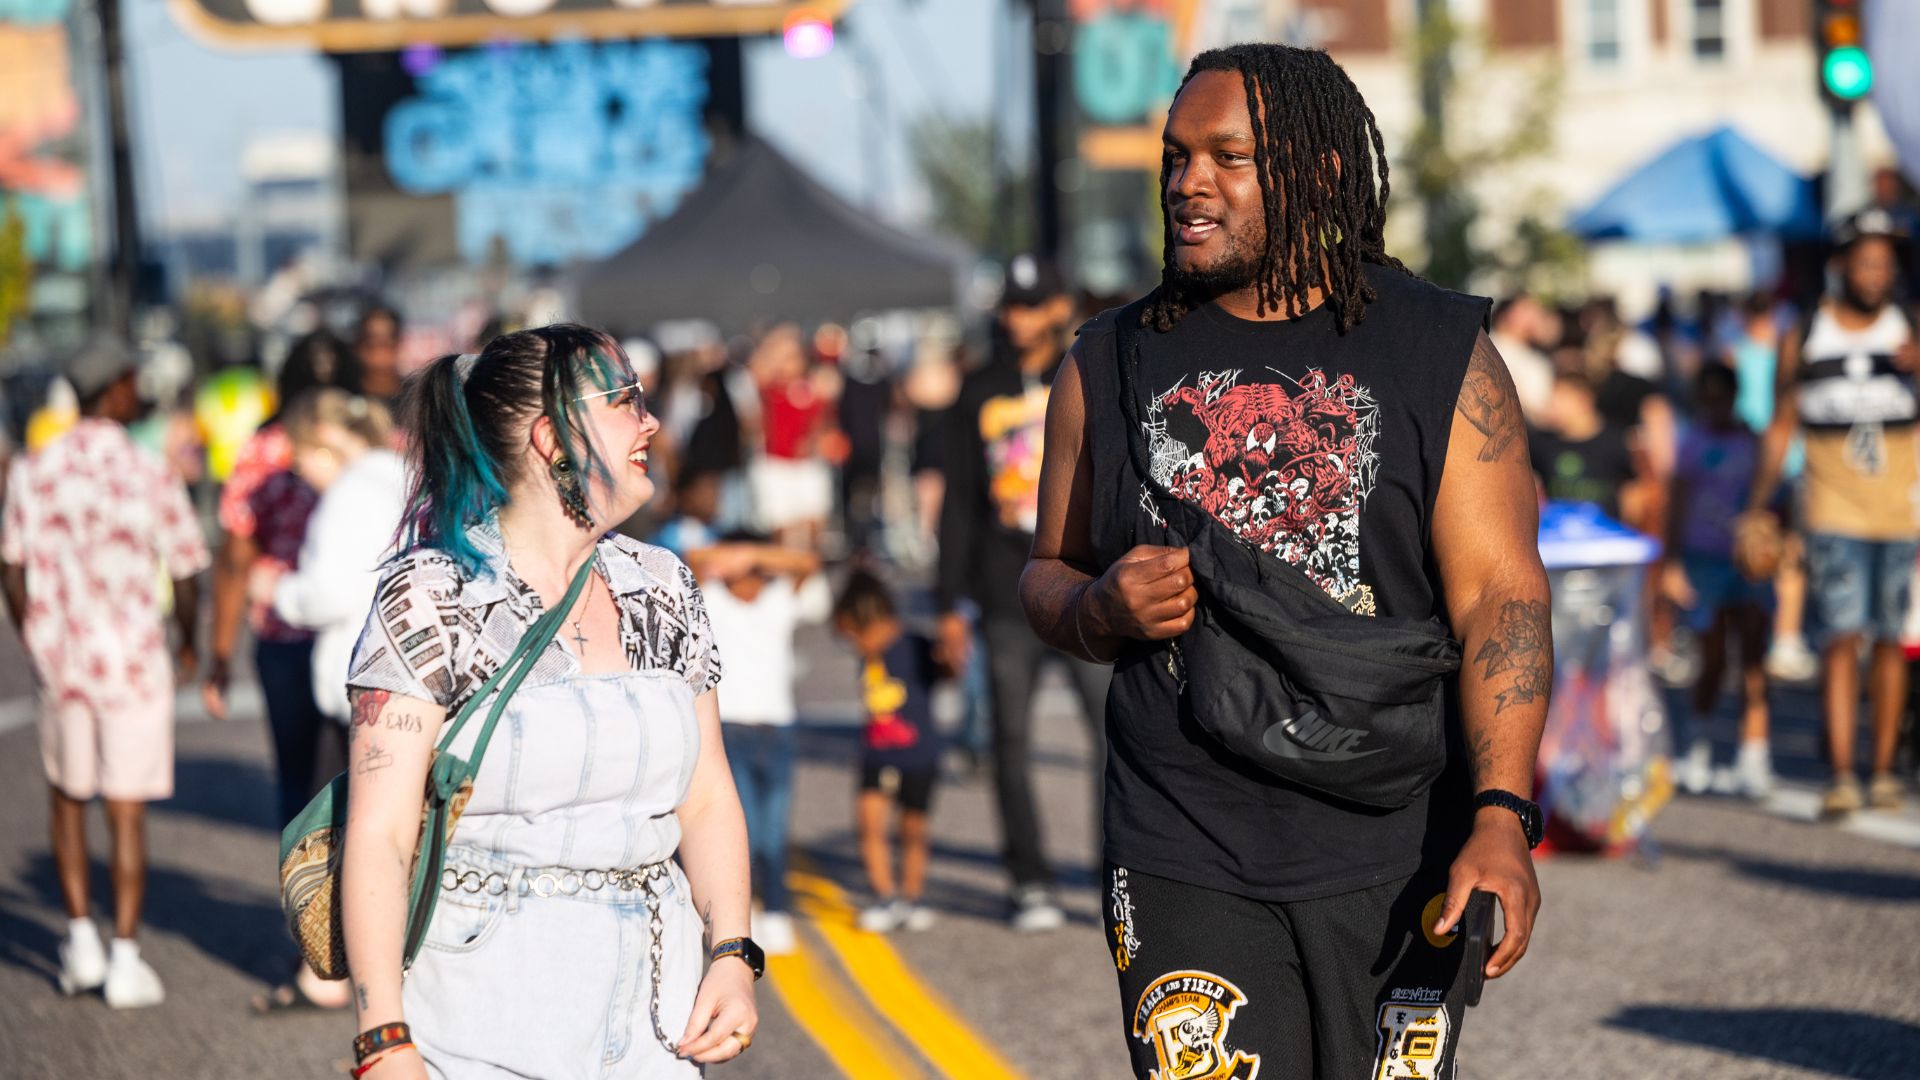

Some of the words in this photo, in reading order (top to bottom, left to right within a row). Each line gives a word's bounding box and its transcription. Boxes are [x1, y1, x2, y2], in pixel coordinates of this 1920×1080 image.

[1285, 710, 1370, 753] NIKE
[1139, 985, 1166, 1023] TRACK
[1182, 977, 1225, 1000] FIELD
[1155, 995, 1180, 1013] CHAMPS
[1181, 995, 1200, 1003] TEAM
